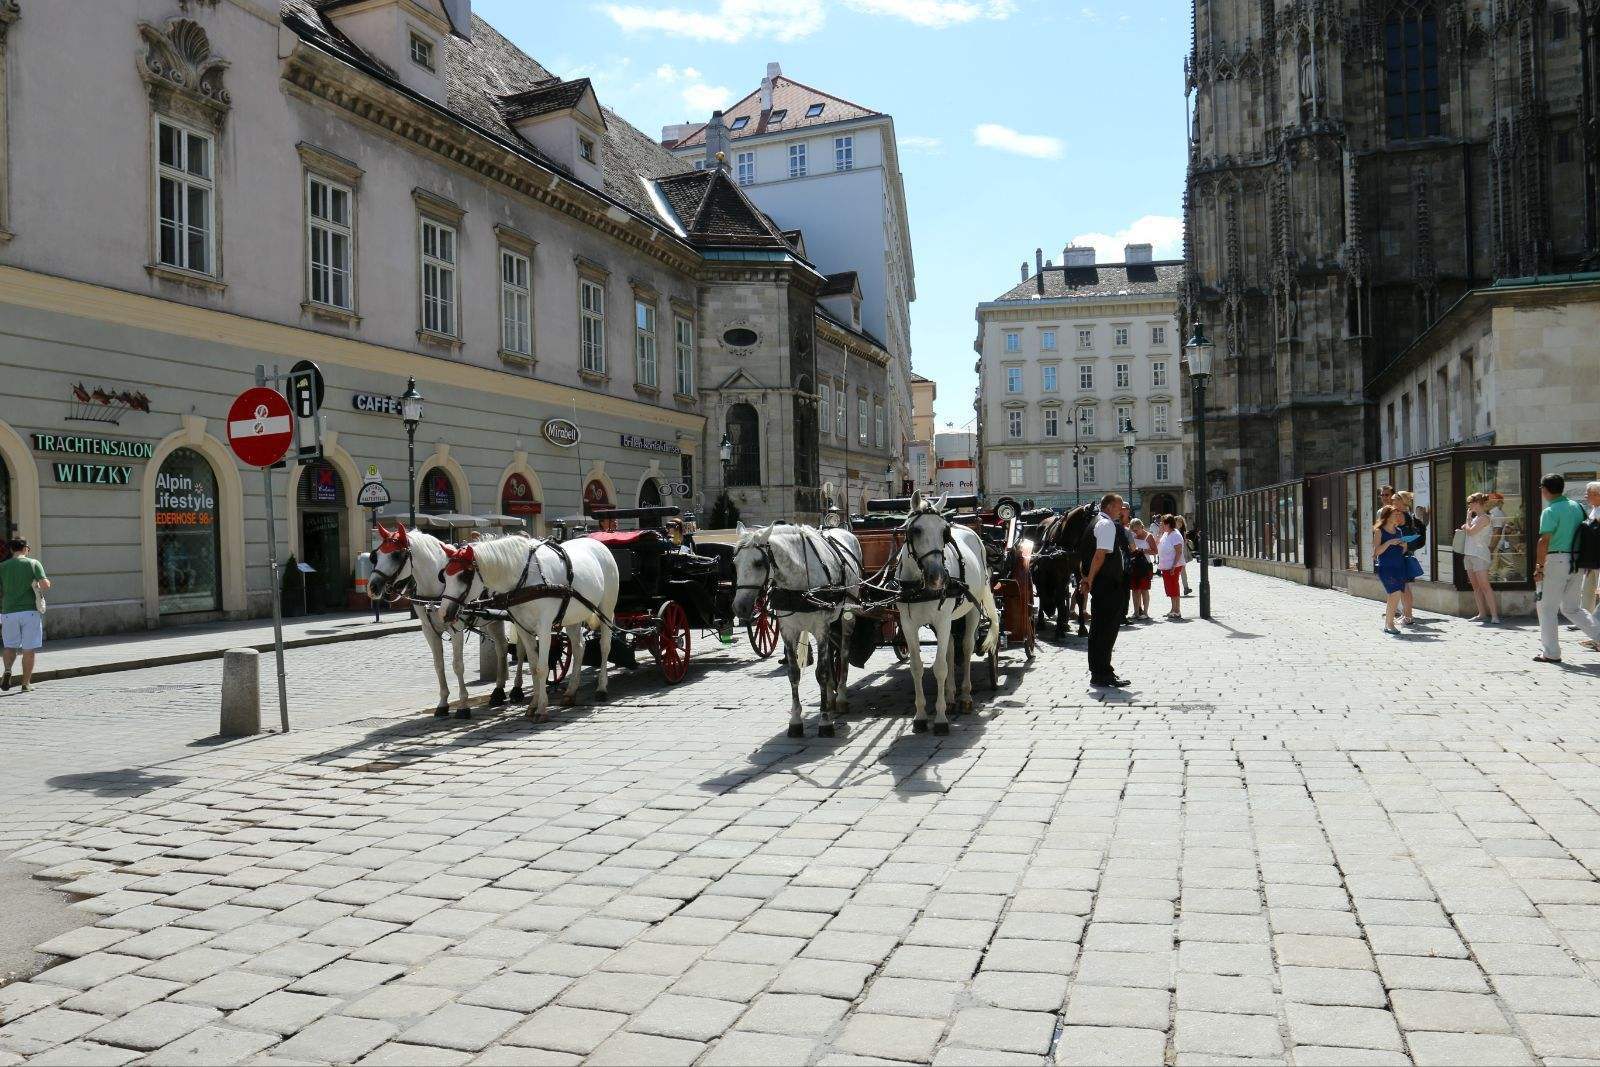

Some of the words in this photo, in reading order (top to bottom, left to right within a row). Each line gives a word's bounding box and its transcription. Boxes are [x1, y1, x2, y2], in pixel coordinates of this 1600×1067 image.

[548, 423, 576, 441] Mirabell
[35, 434, 153, 458] TRACHTENSALON
[57, 463, 132, 484] WITZKY
[155, 472, 192, 492] Alpin
[153, 512, 196, 525] EDERHOSE
